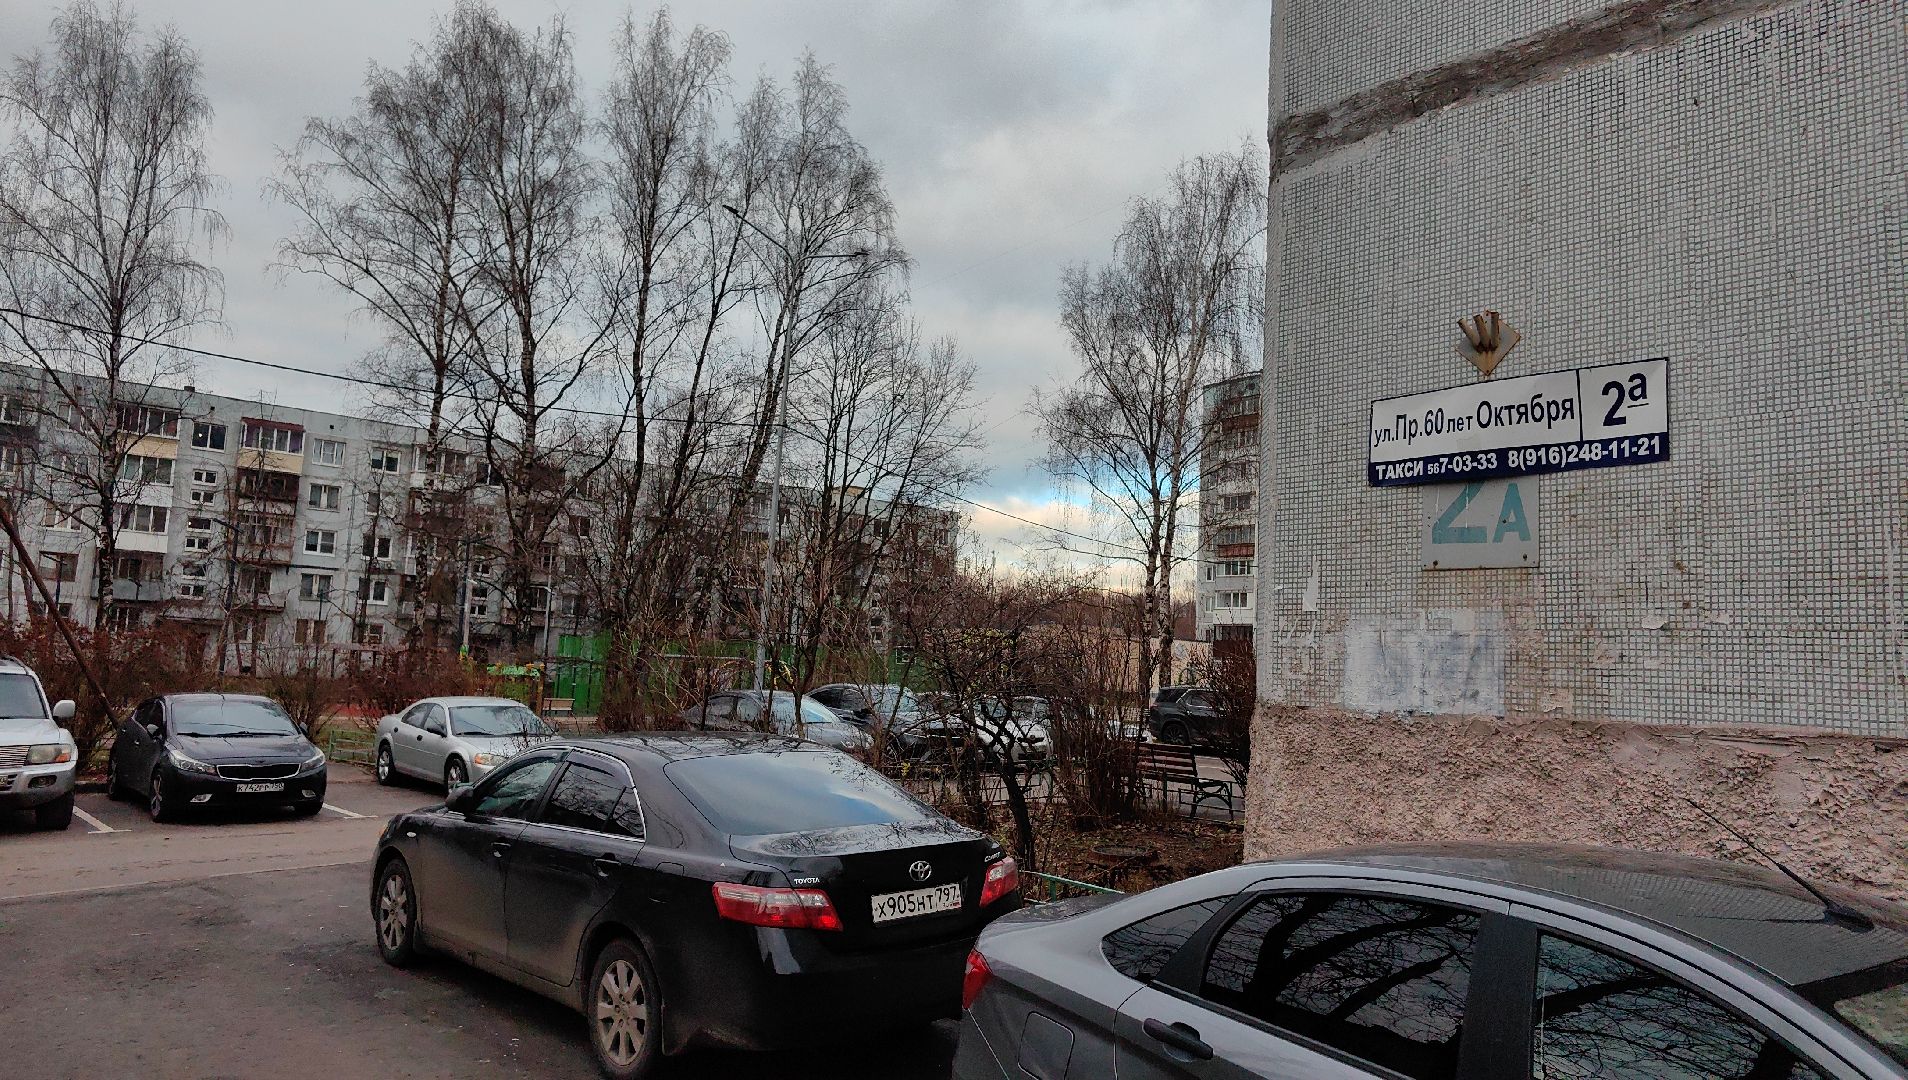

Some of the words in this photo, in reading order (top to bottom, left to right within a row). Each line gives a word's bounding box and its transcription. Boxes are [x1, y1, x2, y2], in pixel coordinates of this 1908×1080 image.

[1476, 393, 1575, 430] Октября
[1601, 373, 1649, 427] 2а
[1375, 460, 1424, 481] ТАКСИ
[1507, 435, 1660, 471] 8(916)248-11-21
[793, 877, 820, 885] TOYOTA
[935, 886, 957, 903] 797
